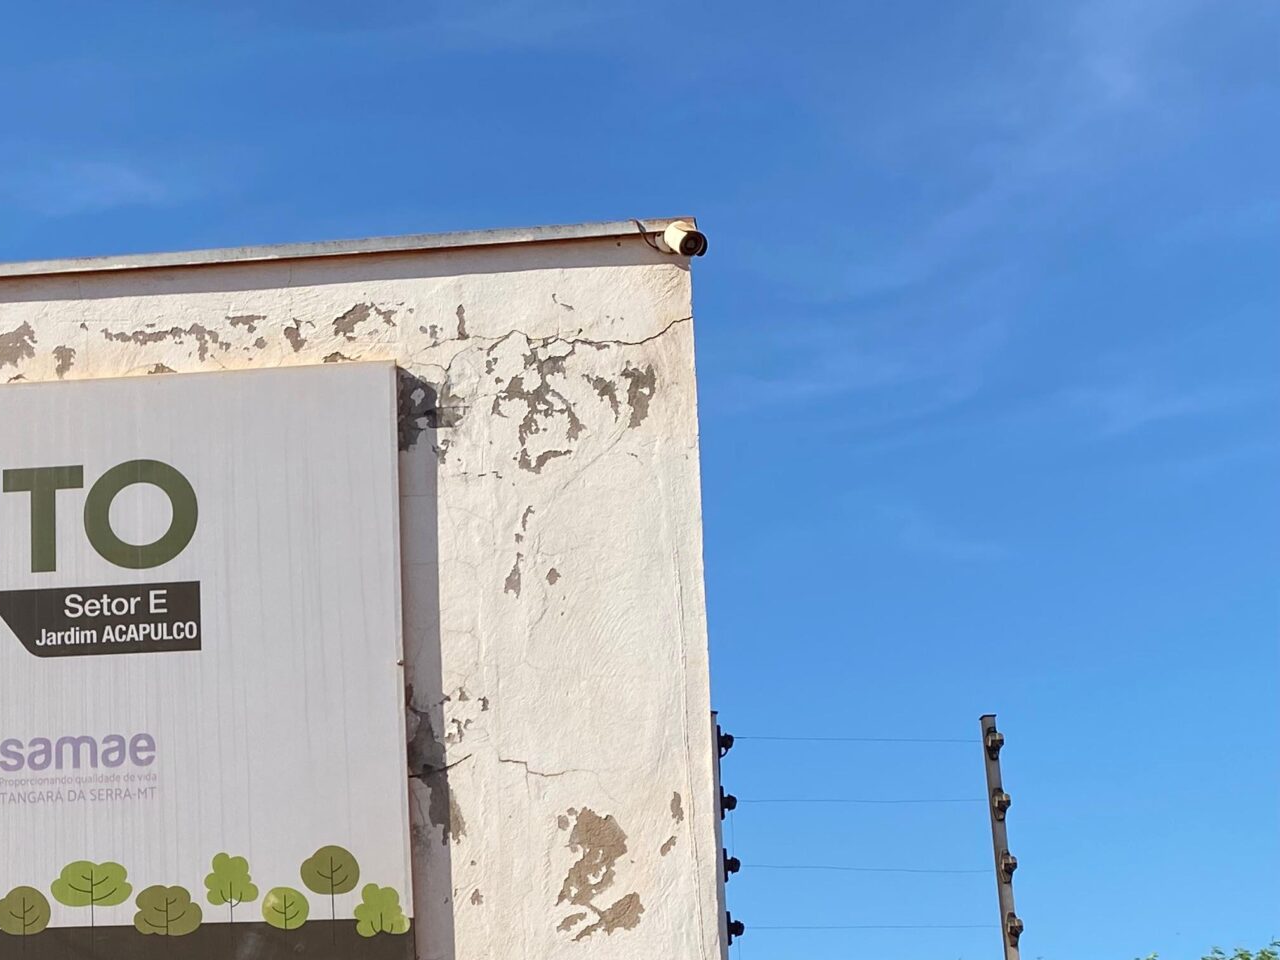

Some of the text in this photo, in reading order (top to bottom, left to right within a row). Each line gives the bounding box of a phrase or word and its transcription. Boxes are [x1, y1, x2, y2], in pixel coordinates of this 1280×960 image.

[64, 589, 168, 618] Setor E
[35, 621, 198, 647] Jardim ACAPULCO
[0, 733, 156, 772] samae
[123, 773, 134, 783] de
[0, 786, 157, 804] TANGARÁ DA SERRA-MT
